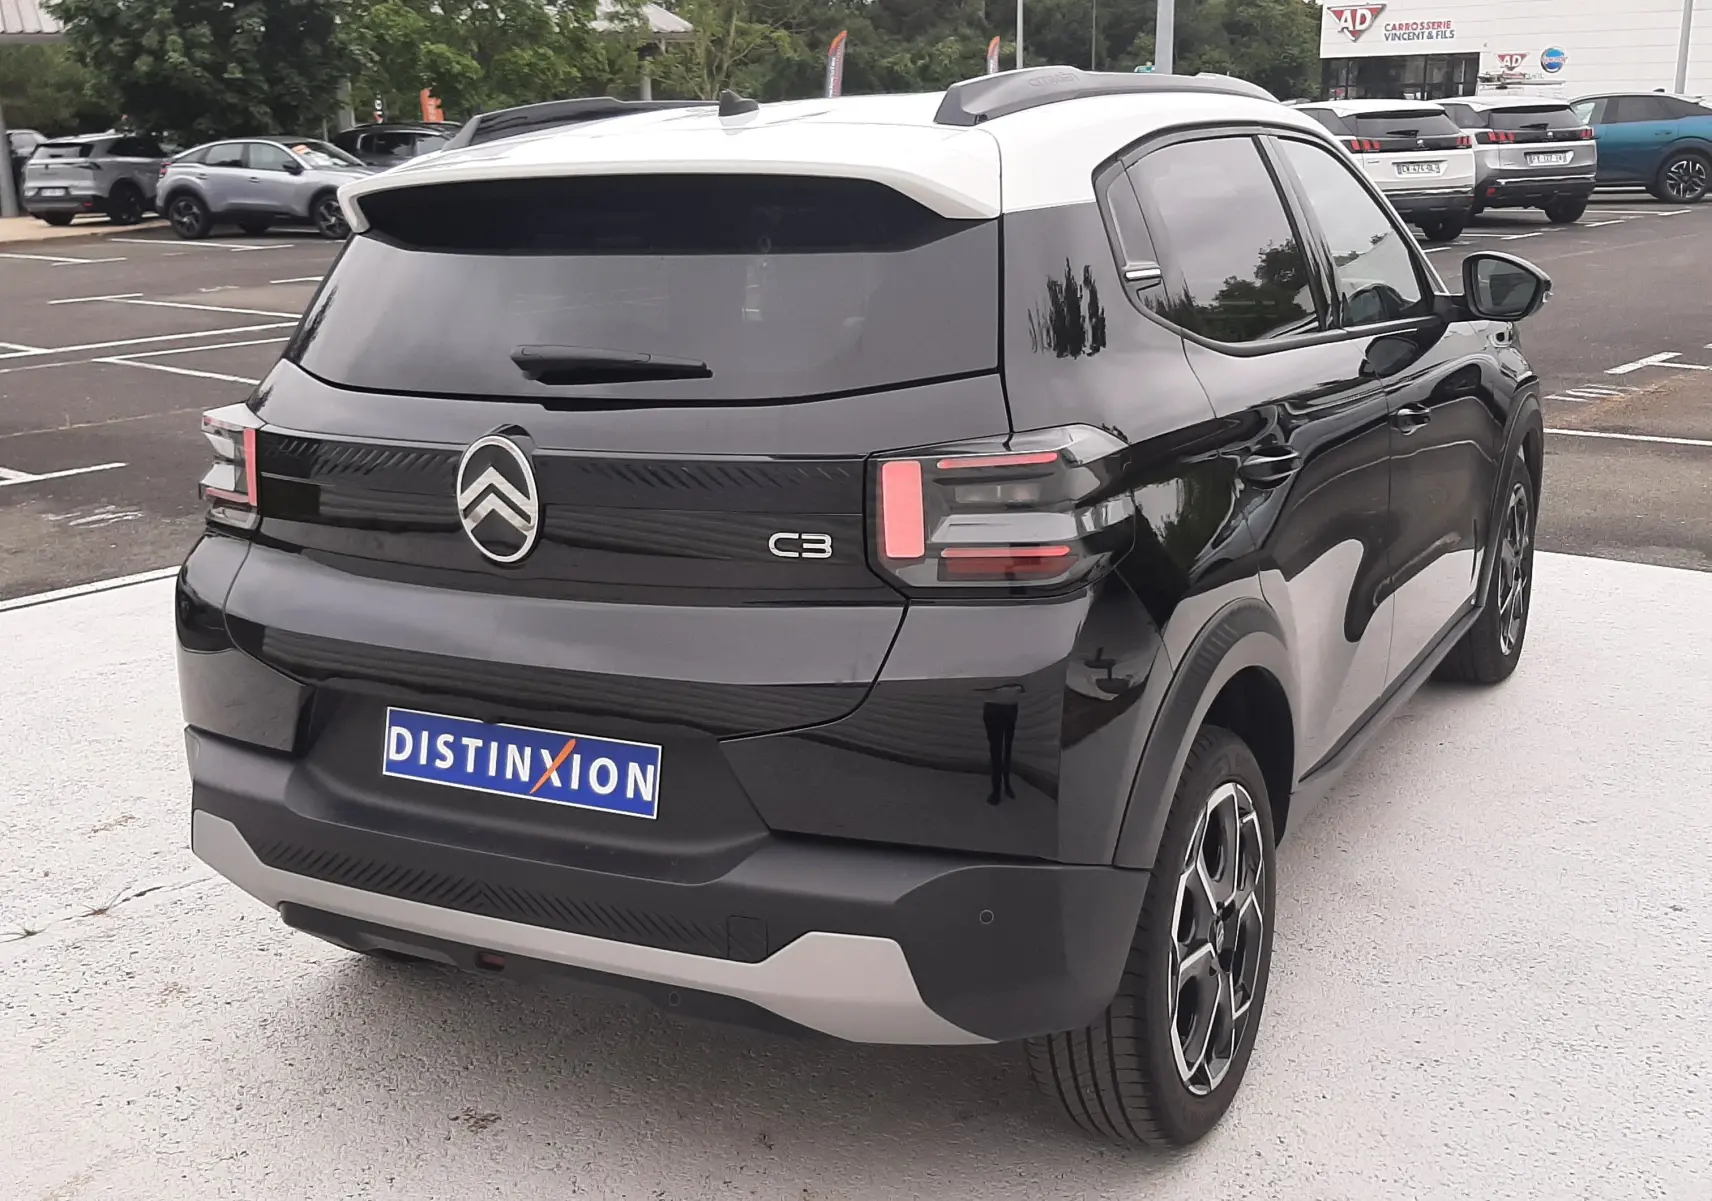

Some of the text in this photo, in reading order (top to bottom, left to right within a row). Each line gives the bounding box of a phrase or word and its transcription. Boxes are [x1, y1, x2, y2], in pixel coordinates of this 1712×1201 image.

[1338, 8, 1372, 32] AD
[1384, 20, 1452, 32] CARROSSERIE
[1384, 29, 1455, 41] VINCENT & FILS
[1503, 54, 1522, 67] AD
[768, 532, 832, 559] C3
[387, 725, 655, 802] DISTINXION
